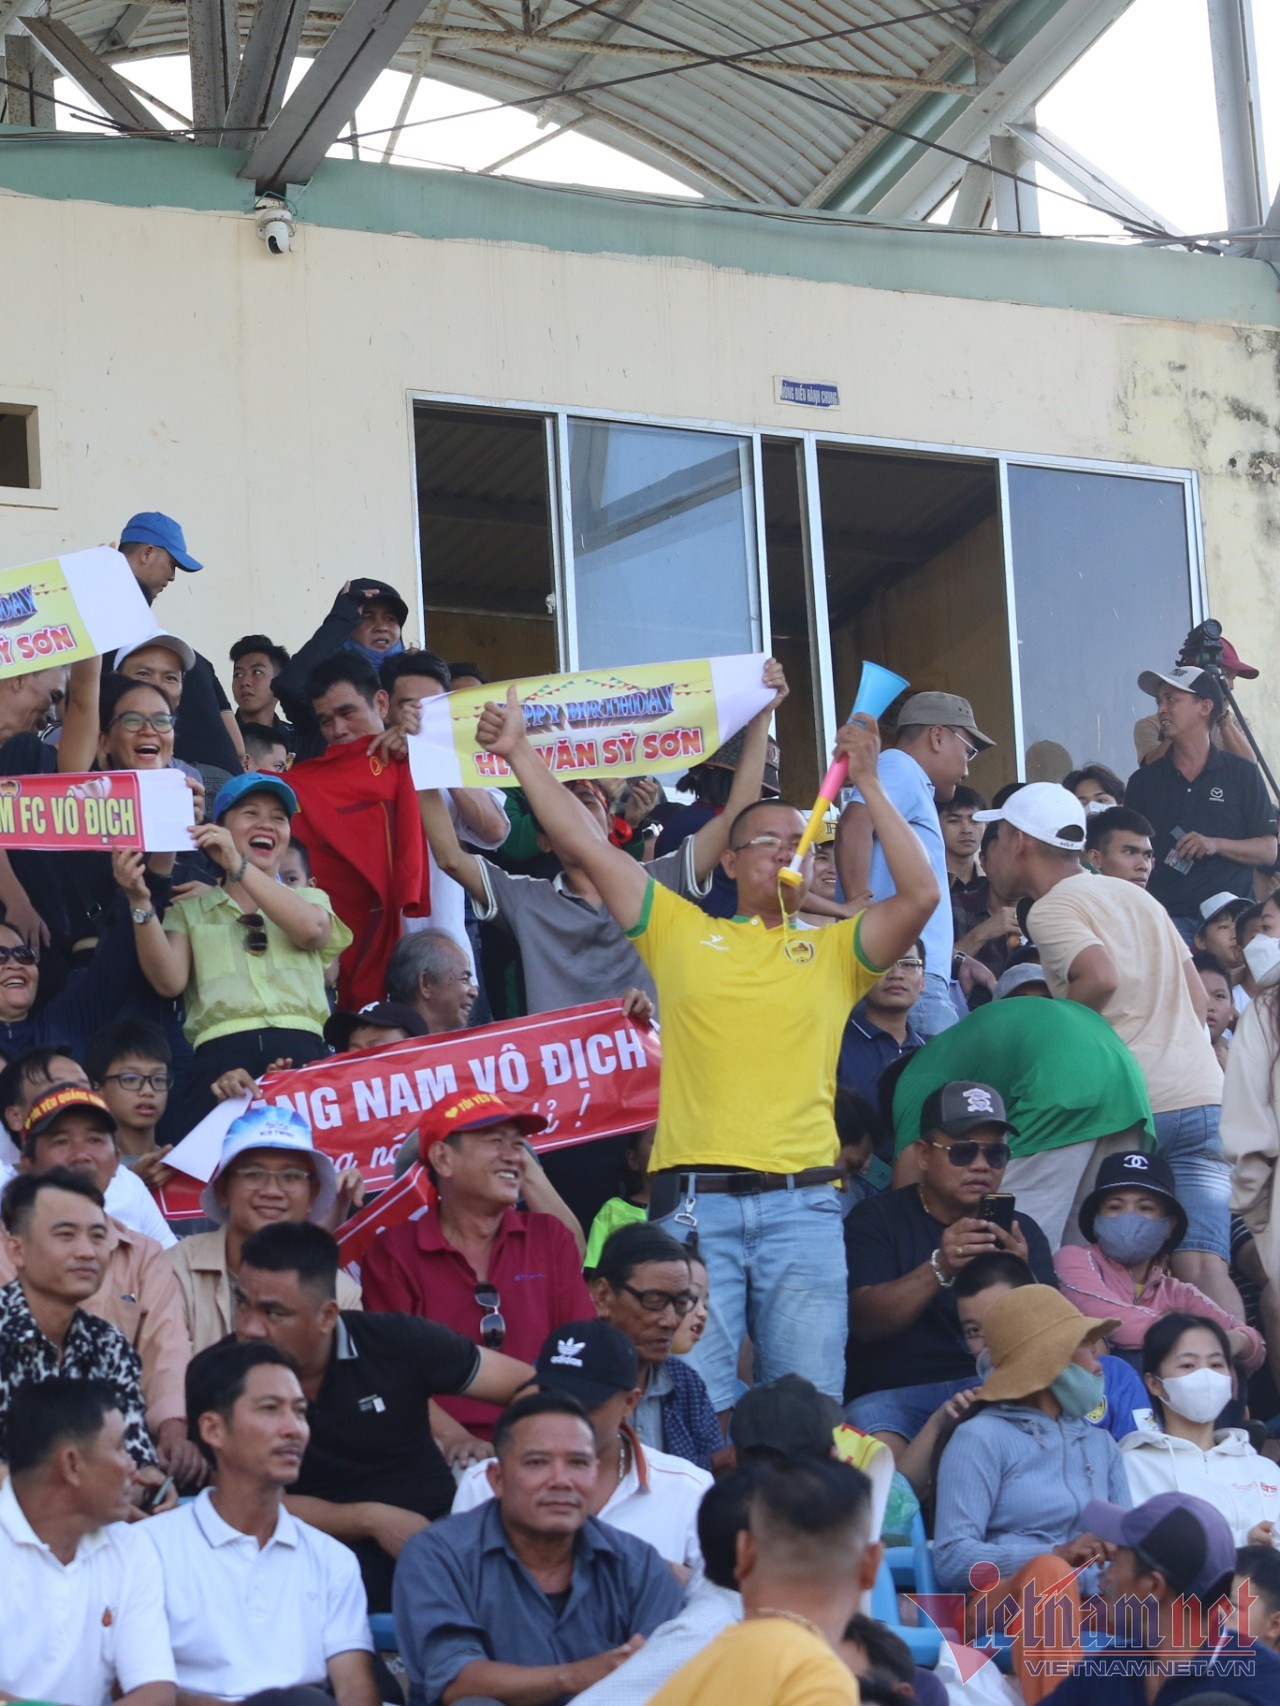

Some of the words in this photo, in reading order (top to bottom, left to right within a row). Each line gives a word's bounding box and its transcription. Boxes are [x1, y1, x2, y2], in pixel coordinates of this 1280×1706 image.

[16, 624, 75, 659] SƠN
[566, 683, 676, 721] BIRTHDAY
[474, 752, 511, 776] HL
[535, 739, 597, 770] VĂN
[602, 734, 639, 764] SỸ
[643, 728, 703, 760] SƠN
[21, 798, 46, 835] FC
[51, 790, 79, 835] VÔ
[84, 798, 136, 844] ĐỊCH
[351, 1063, 457, 1123] NAM
[468, 1042, 529, 1093] VÔ
[541, 1028, 648, 1089] ĐỊCH
